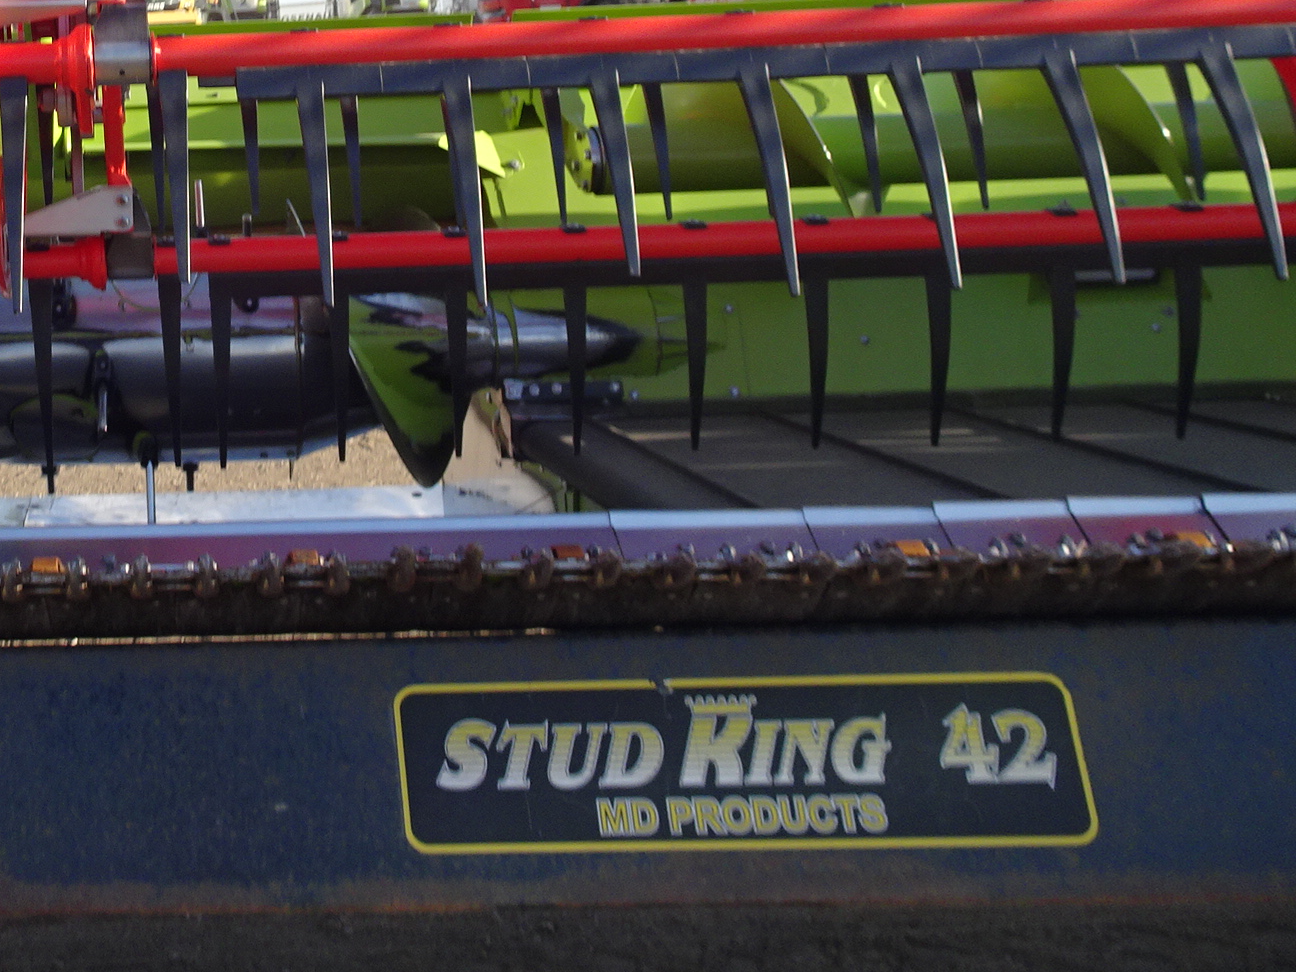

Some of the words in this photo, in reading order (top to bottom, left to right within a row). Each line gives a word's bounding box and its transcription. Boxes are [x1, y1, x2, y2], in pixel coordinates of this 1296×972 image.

[436, 718, 664, 791] STUD
[680, 697, 892, 788] KING
[940, 703, 1057, 791] 42
[597, 797, 659, 837] MD
[666, 793, 889, 837] PRODUCTS
